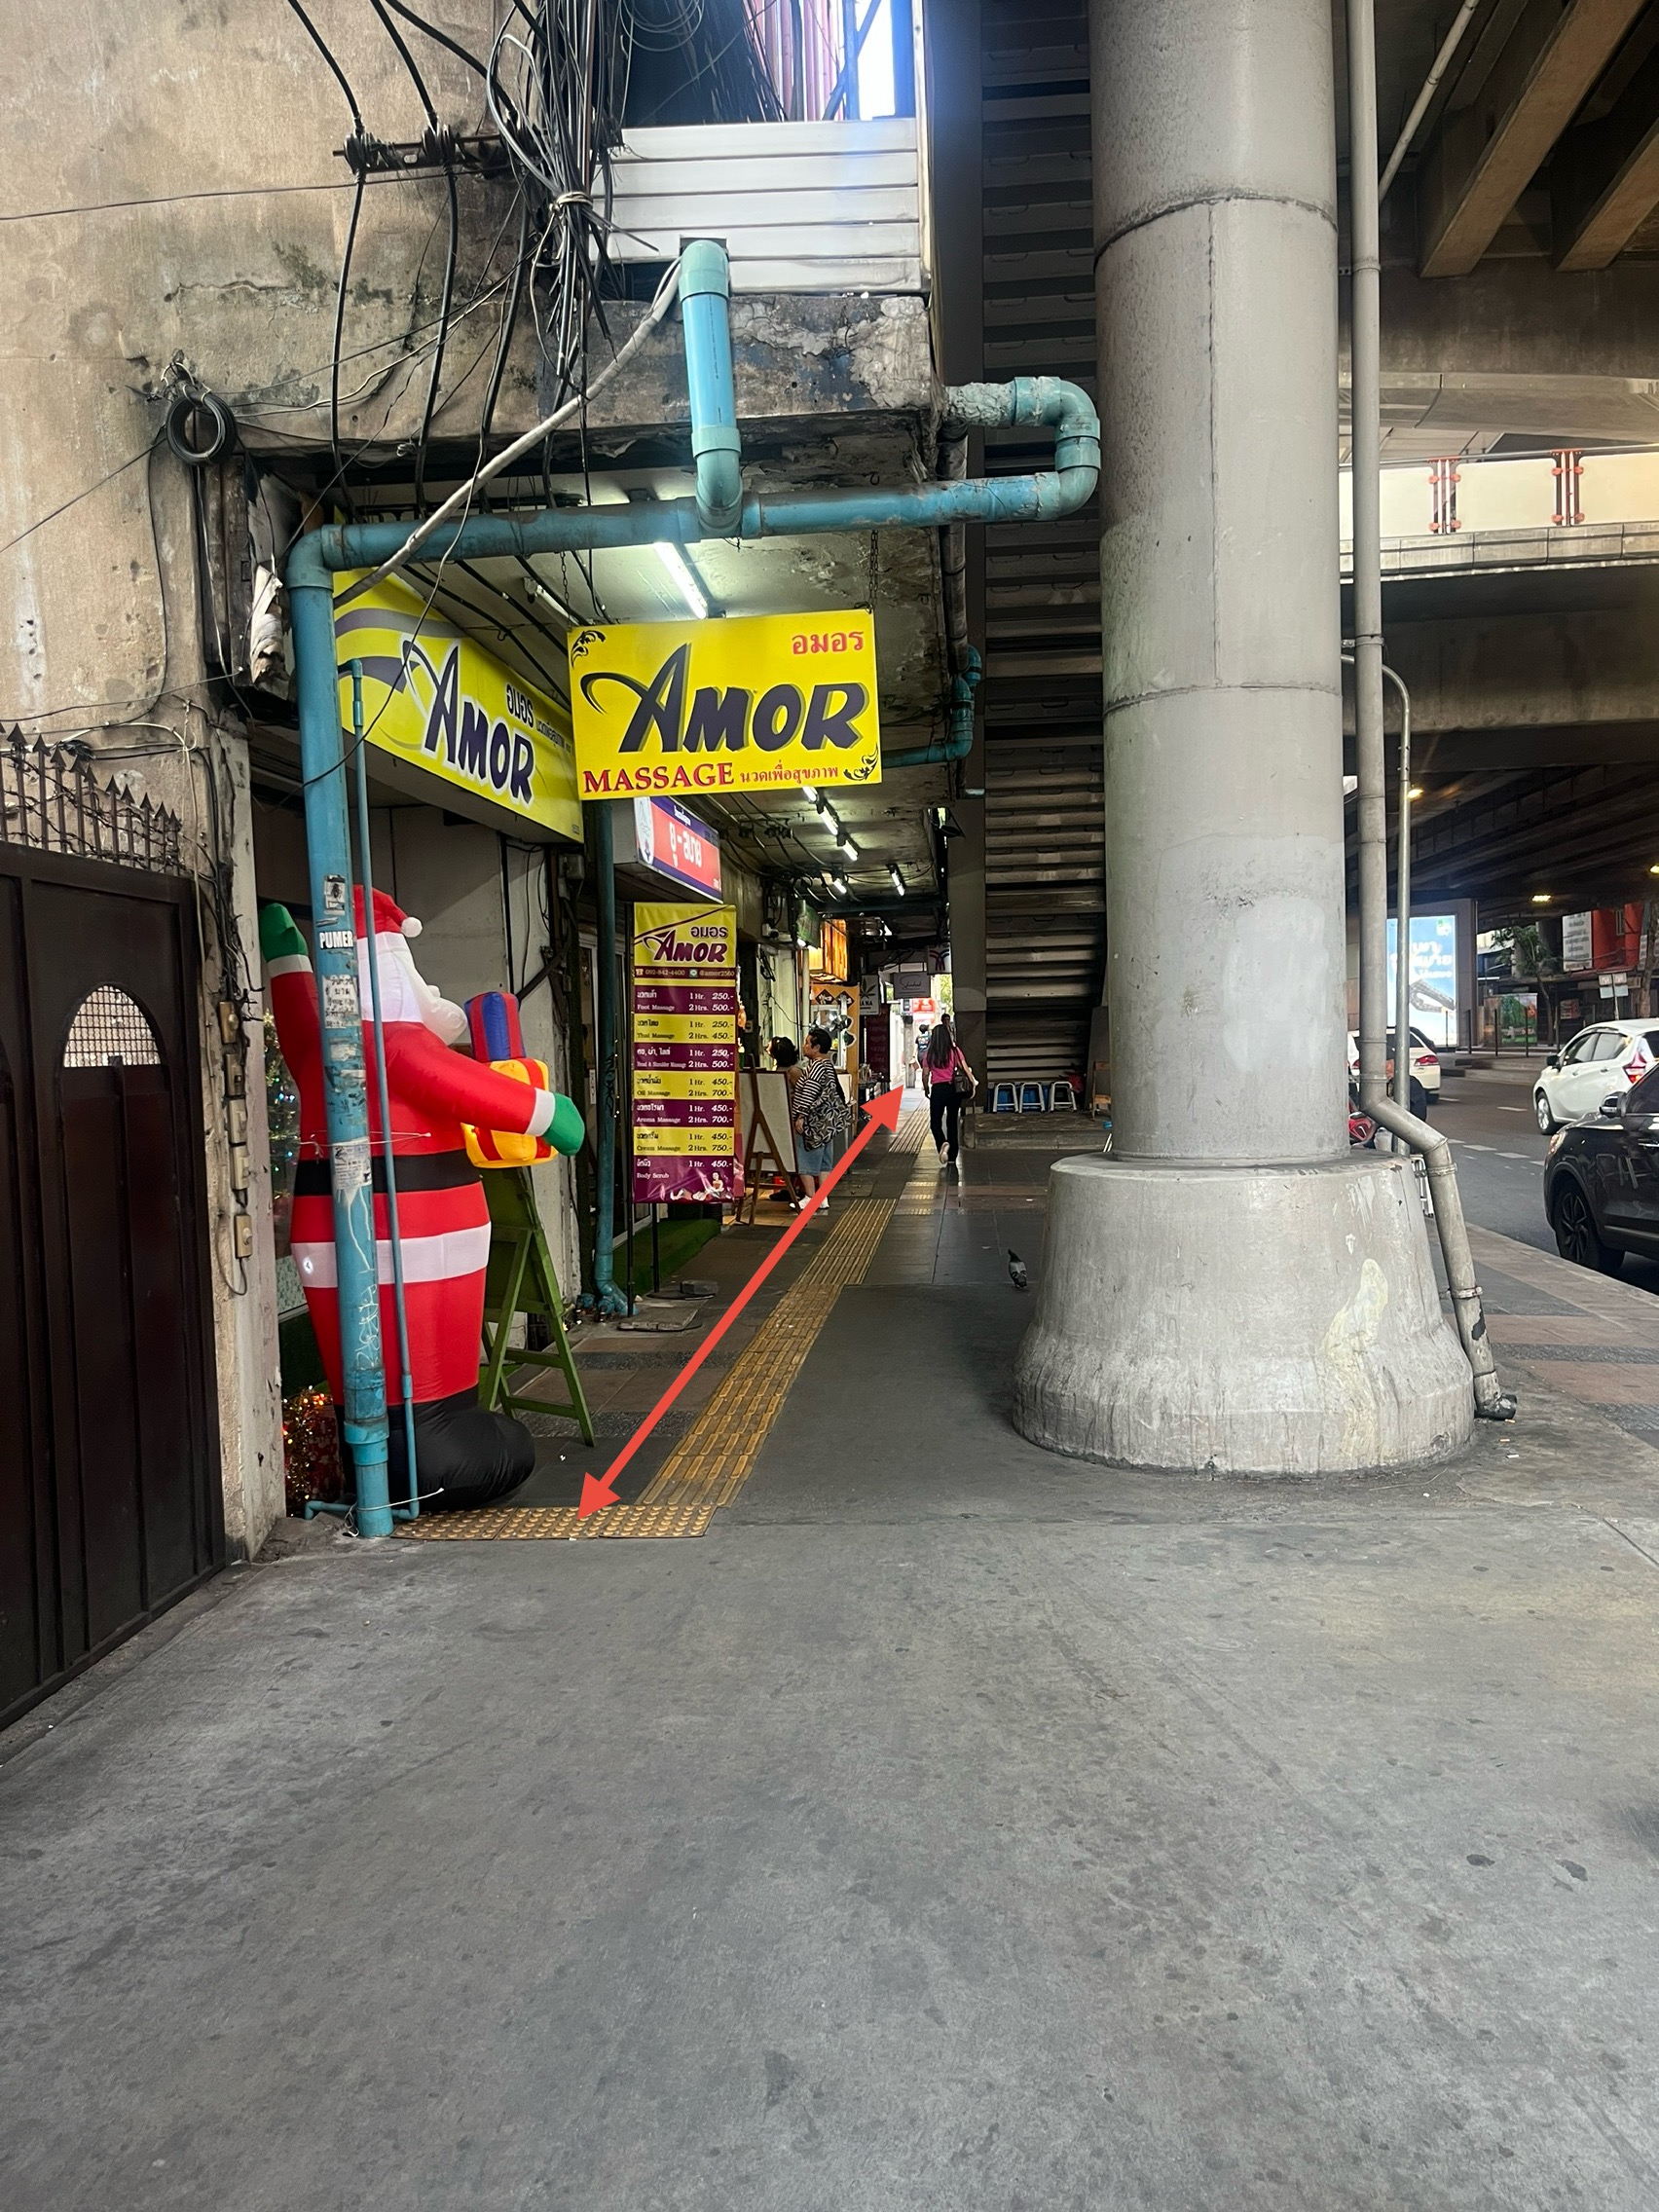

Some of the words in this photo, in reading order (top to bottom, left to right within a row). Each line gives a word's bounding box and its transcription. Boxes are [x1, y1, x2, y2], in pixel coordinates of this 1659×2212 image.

[792, 630, 865, 655] อมอร
[506, 683, 534, 728] อมอร
[580, 642, 870, 754] AMOR
[402, 639, 535, 804] AMOR
[583, 762, 735, 793] MASSAGE
[739, 759, 839, 784] นวดเพื่อสุขภาพ
[643, 929, 728, 962] AMOR
[691, 926, 728, 938] อมอร
